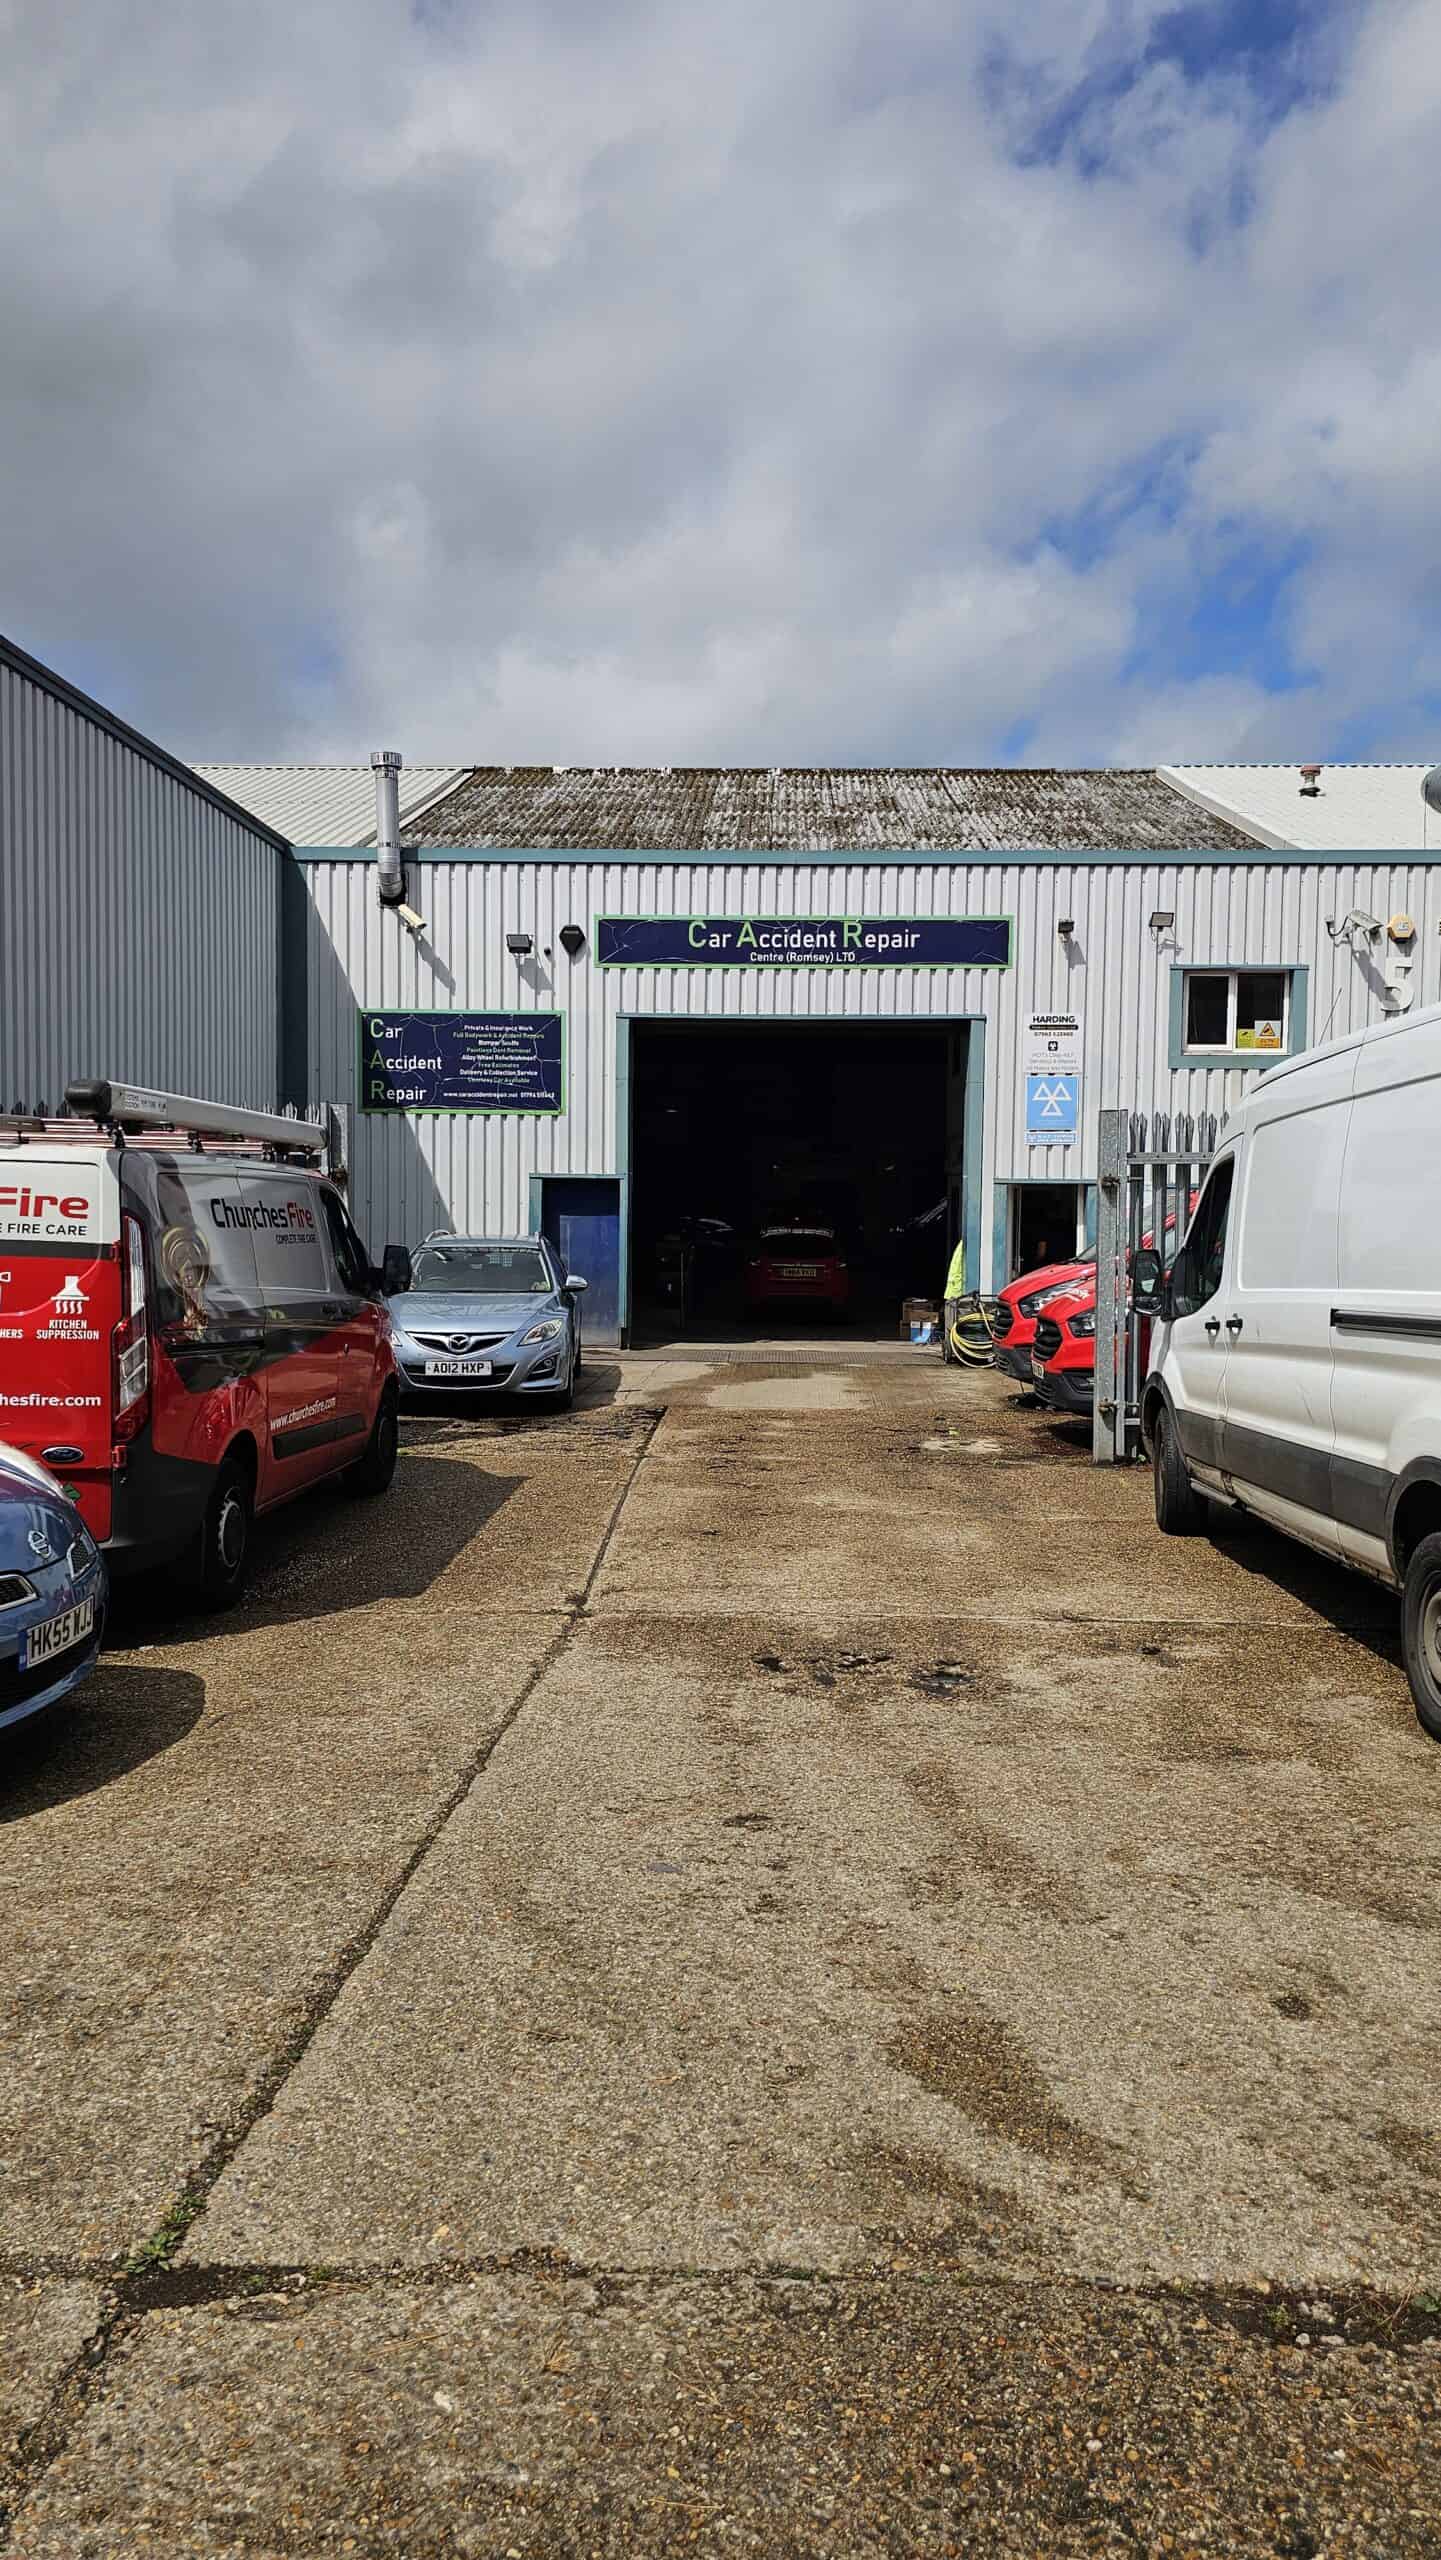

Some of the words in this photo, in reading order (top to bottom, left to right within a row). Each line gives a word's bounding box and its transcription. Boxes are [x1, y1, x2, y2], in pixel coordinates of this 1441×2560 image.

[688, 920, 732, 948] Car
[736, 920, 836, 948] Accident
[843, 920, 921, 952] Repair
[750, 952, 784, 962] Centre
[786, 952, 834, 964] (Romsey)
[836, 952, 856, 962] LTD
[1383, 956, 1416, 1012] 5
[370, 1018, 403, 1038] Car
[1032, 1015, 1076, 1023] HARDING
[370, 1049, 443, 1070] Accident
[371, 1080, 427, 1103] Repair
[210, 1198, 315, 1230] ChurchesFire
[8, 1223, 41, 1234] FIRE
[46, 1224, 89, 1236] CARE
[49, 1319, 87, 1330] KITCHEN
[36, 1330, 100, 1340] SUPPRESSION
[461, 1363, 485, 1374] HXP
[31, 1614, 70, 1659] HK55
